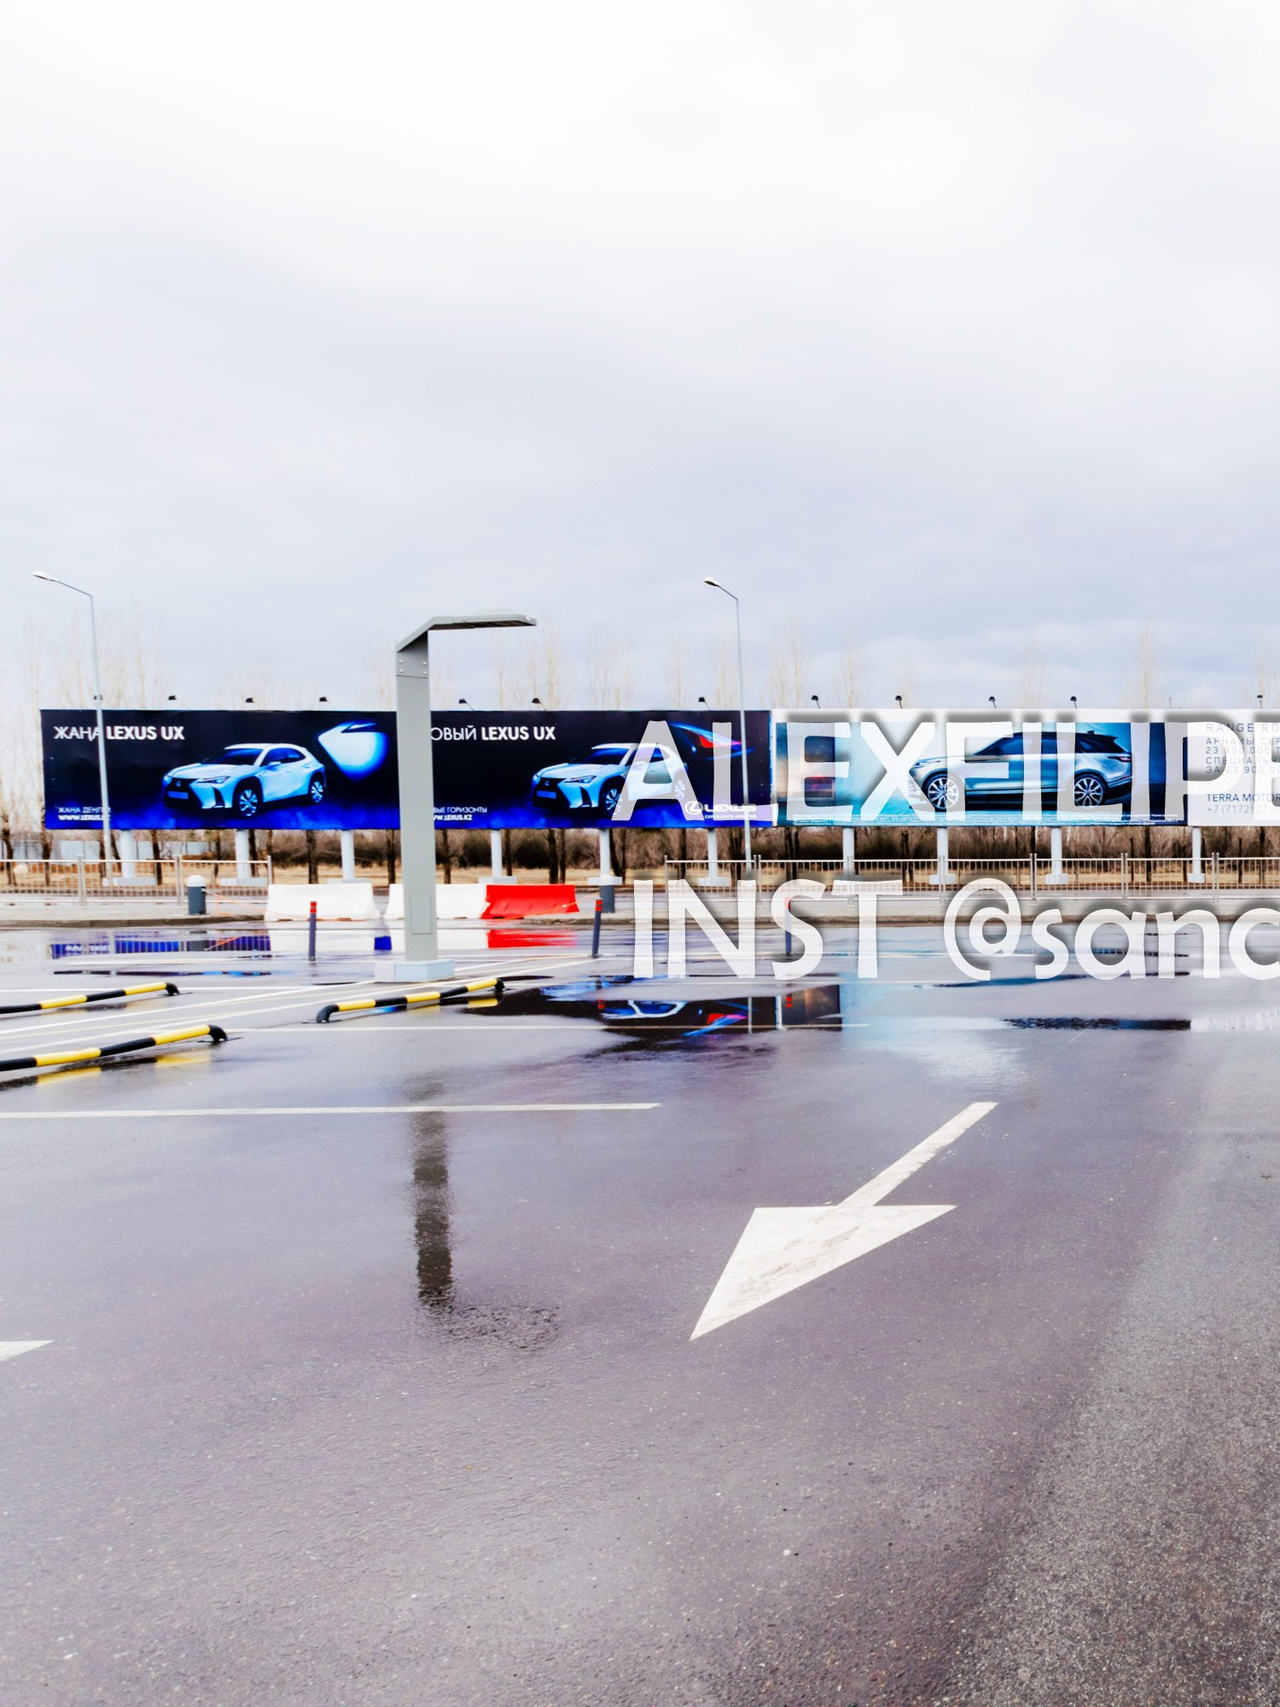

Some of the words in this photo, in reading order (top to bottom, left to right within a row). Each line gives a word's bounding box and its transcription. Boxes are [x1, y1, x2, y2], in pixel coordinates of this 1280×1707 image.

[106, 726, 158, 740] LEXUS
[161, 726, 185, 740] UX
[430, 725, 477, 740] ОВЫЙ
[481, 726, 529, 740] LEXUS
[533, 726, 556, 740] UX
[1206, 722, 1254, 733] RANGE
[1207, 794, 1239, 802] TERRA
